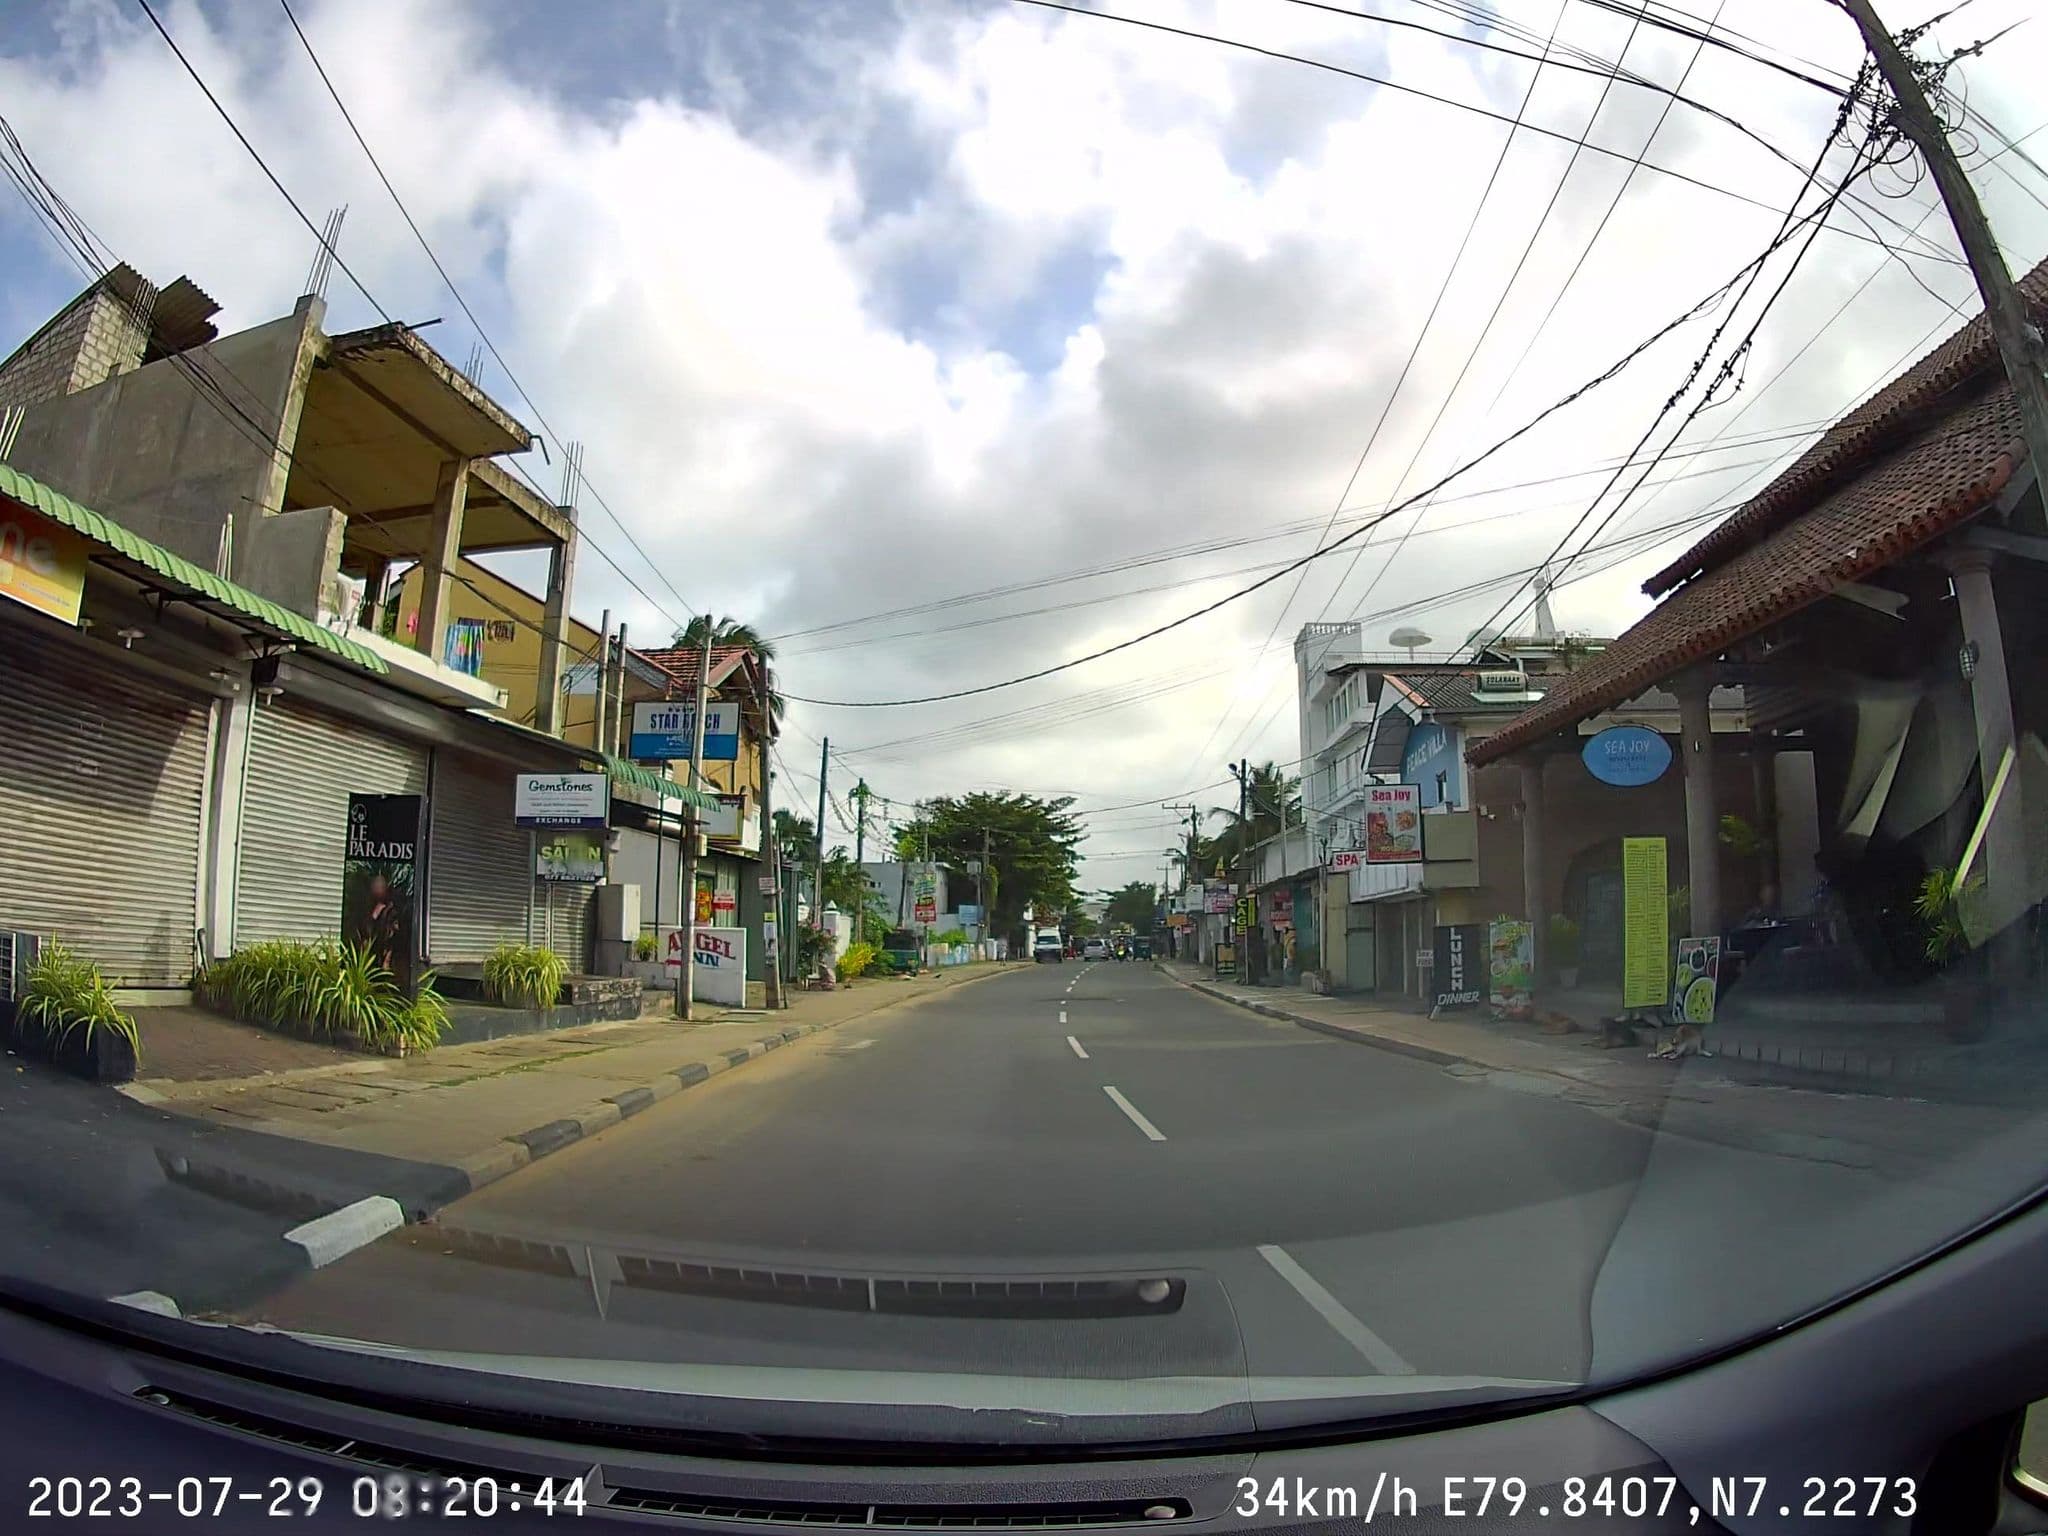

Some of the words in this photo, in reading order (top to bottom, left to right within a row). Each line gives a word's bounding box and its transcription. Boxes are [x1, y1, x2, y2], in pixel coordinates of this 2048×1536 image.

[650, 713, 679, 729] STAR
[682, 713, 720, 729] BECH
[1604, 741, 1626, 755] SEA
[1630, 740, 1651, 753] JOY
[1407, 744, 1427, 776] PEACE
[528, 779, 593, 792] Gemstones
[1372, 789, 1392, 802] Sea
[1394, 789, 1411, 802] Joy
[350, 824, 368, 841] LE
[349, 841, 414, 860] PARADIS
[1336, 853, 1359, 866] SPA
[668, 929, 737, 961] AGEL
[1449, 927, 1464, 991] LUNCH
[1437, 991, 1480, 1006] DINNER
